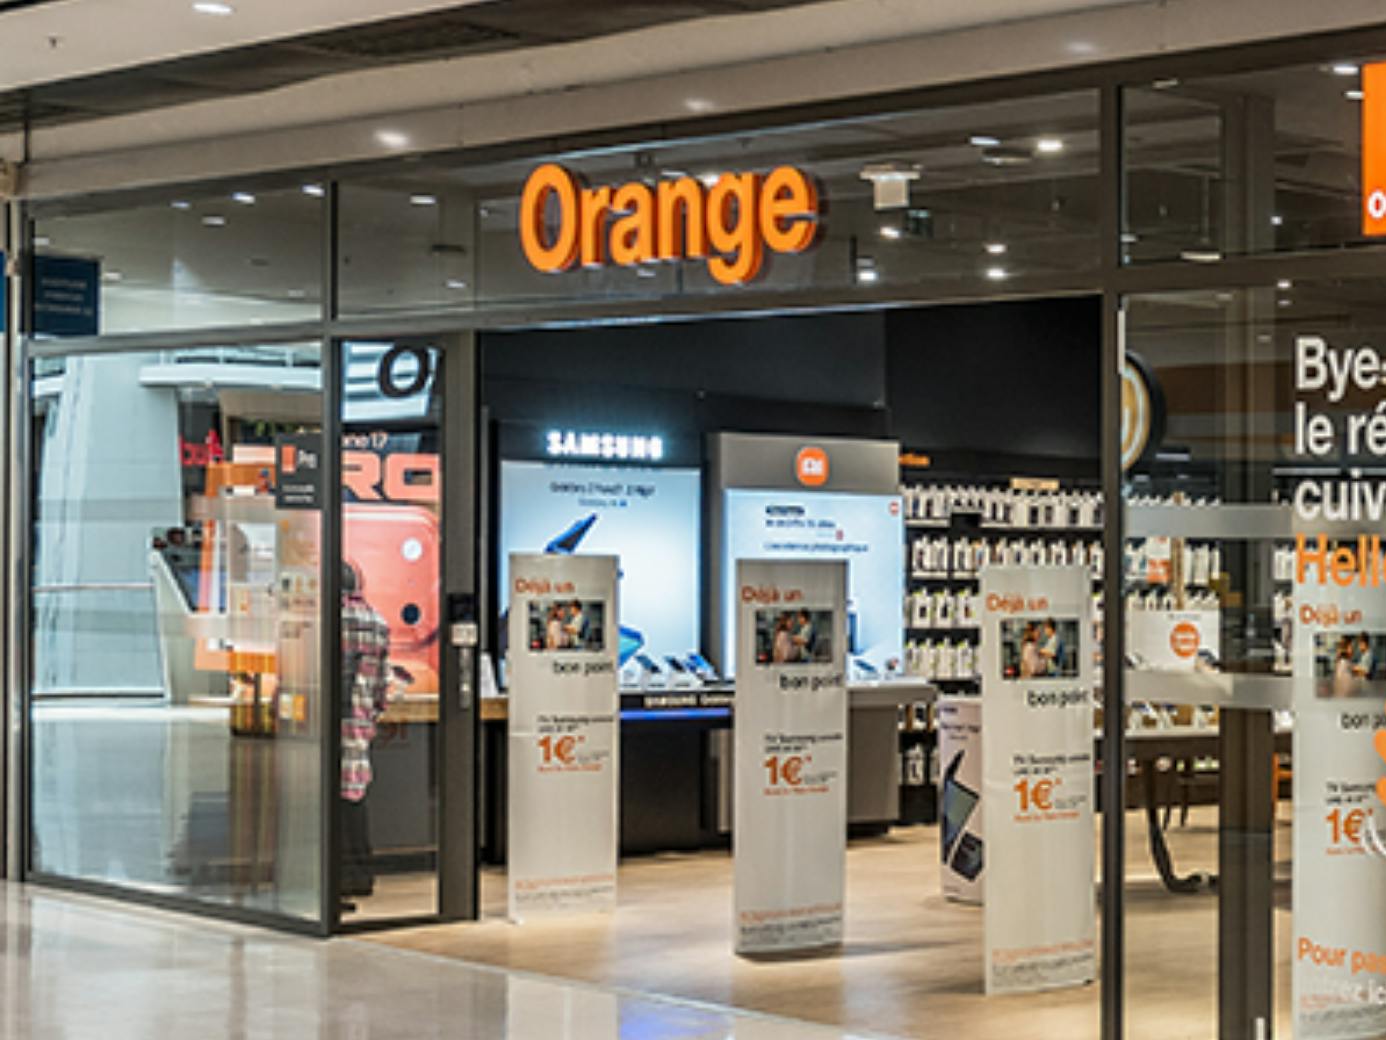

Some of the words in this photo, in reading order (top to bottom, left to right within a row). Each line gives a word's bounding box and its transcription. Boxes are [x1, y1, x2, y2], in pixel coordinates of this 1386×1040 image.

[519, 163, 820, 285] Orange
[1295, 401, 1334, 455] le
[545, 430, 663, 460] SAMSUNG
[1343, 609, 1362, 625] un
[1298, 936, 1347, 967] Pour
